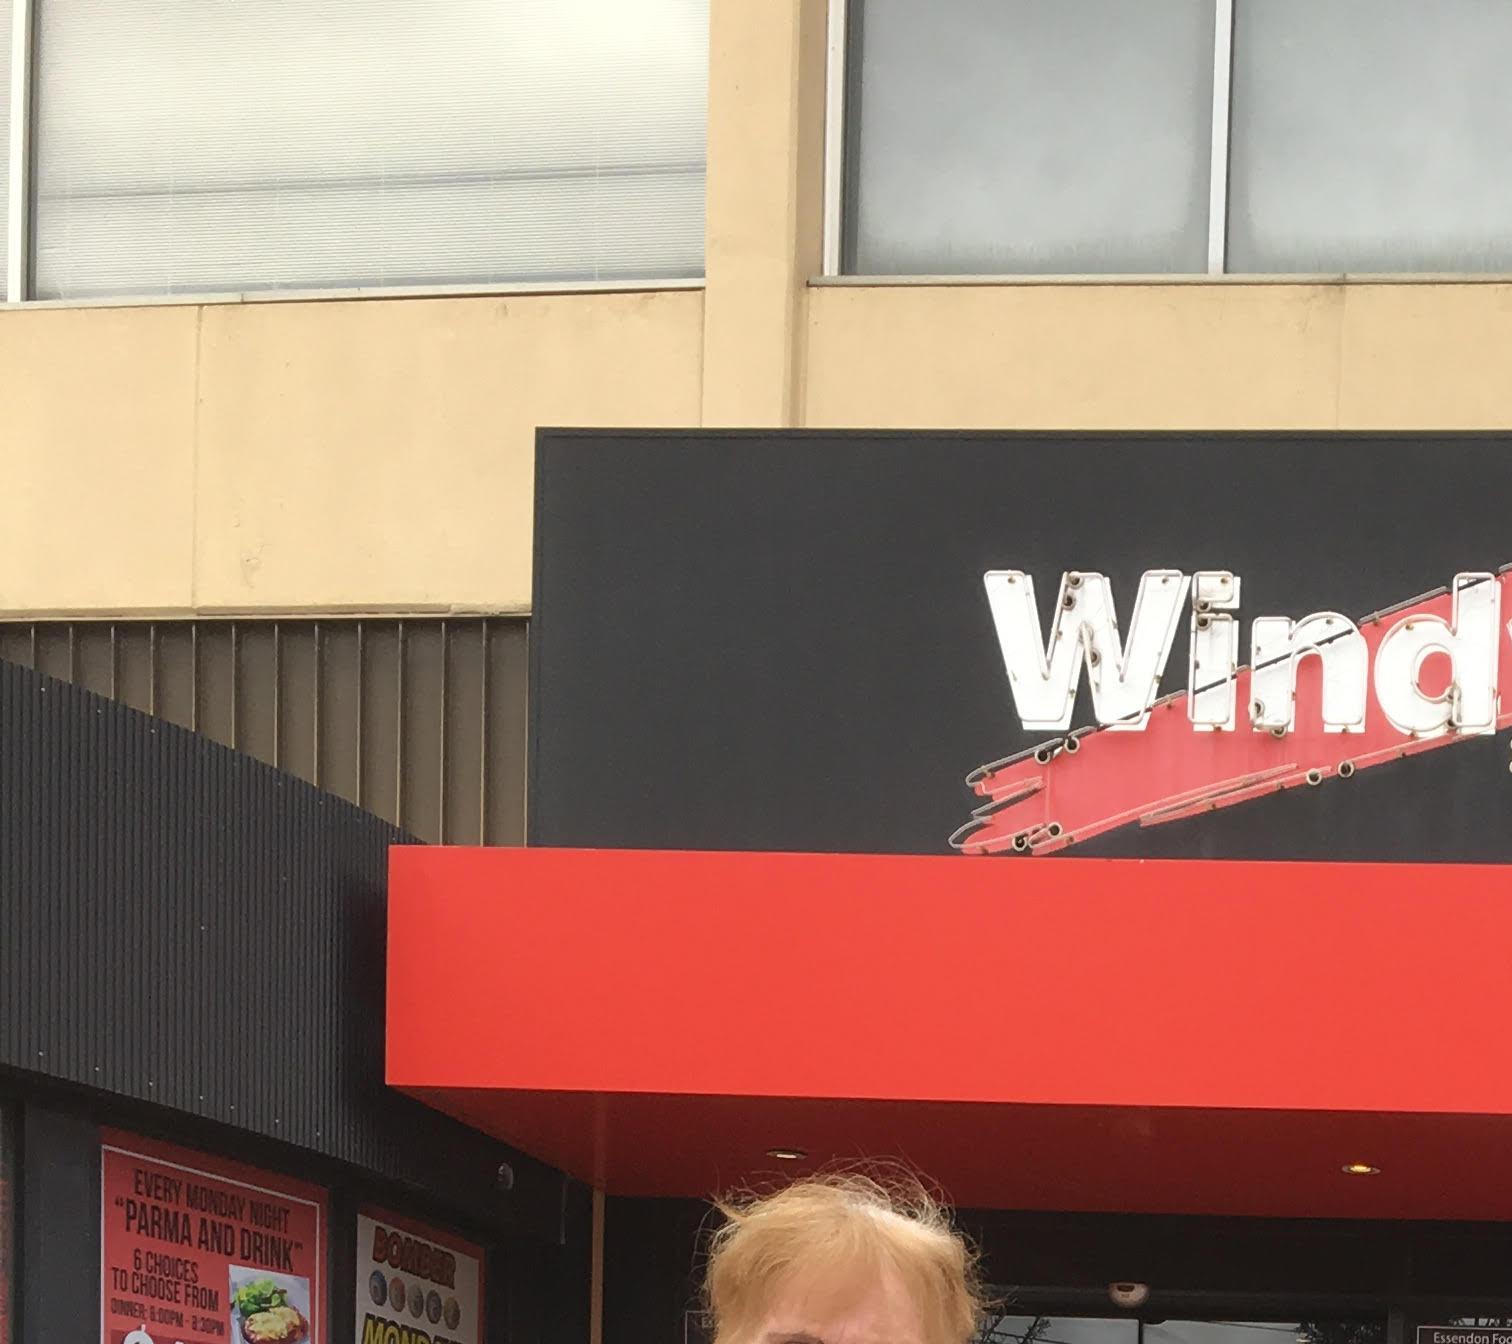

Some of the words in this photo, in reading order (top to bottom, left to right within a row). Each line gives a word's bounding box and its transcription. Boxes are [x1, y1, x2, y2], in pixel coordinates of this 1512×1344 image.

[134, 1168, 182, 1203] EVERY
[185, 1183, 246, 1221] MONDAY
[250, 1199, 290, 1234] NIGHT
[133, 1248, 142, 1270] 6
[146, 1250, 199, 1283] CHOICES
[112, 1267, 128, 1292] TO
[131, 1271, 181, 1304] CHOOSE
[185, 1286, 219, 1313] FROM
[1433, 1332, 1490, 1344] Essendon
